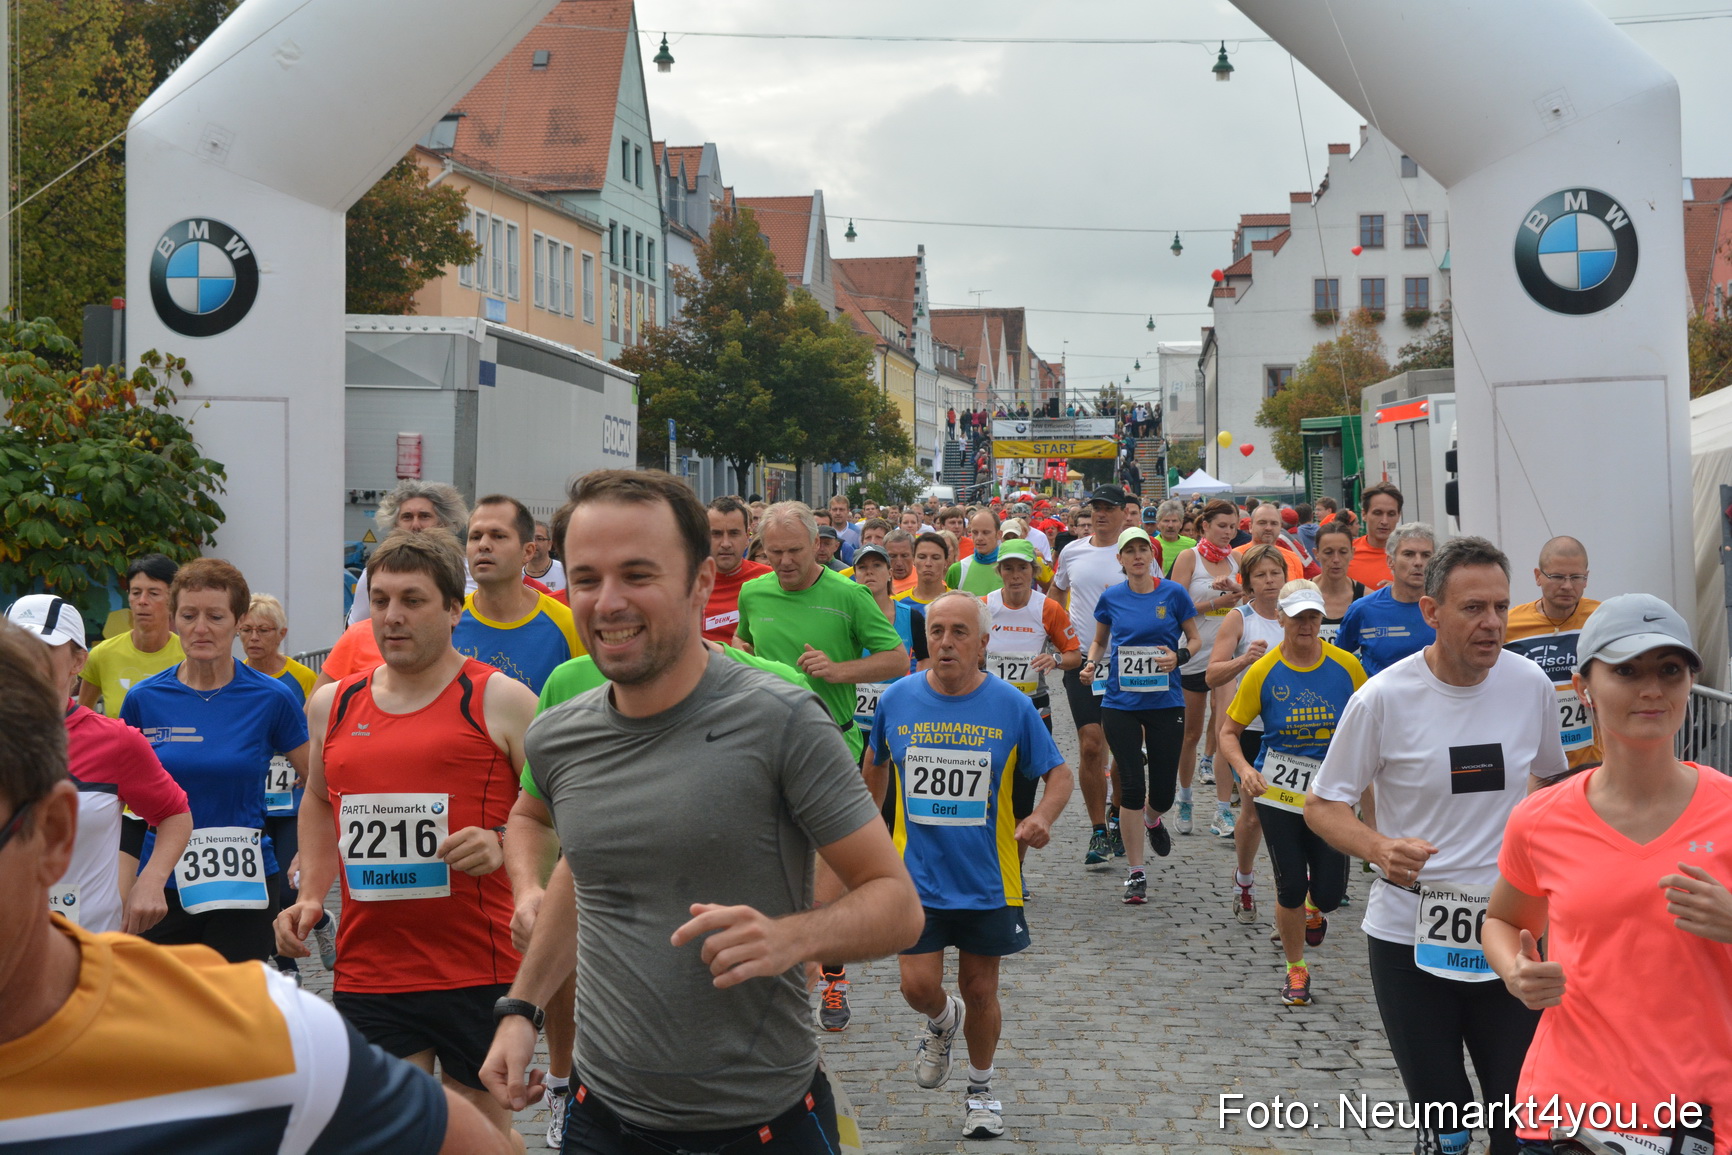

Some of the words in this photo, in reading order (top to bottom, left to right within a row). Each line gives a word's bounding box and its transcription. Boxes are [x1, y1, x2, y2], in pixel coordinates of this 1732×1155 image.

[1524, 191, 1629, 234] BMW
[157, 220, 250, 260] BMW
[602, 414, 632, 458] BOCK
[1033, 443, 1077, 454] START
[1003, 625, 1035, 633] KLEBL
[997, 662, 1028, 680] 127
[898, 724, 911, 736] 10.
[913, 722, 1004, 740] NEUMARKTER
[910, 733, 986, 747] STADTLAUF
[907, 755, 935, 764] PARTL
[936, 757, 976, 766] Neumarkt
[1267, 751, 1286, 762] PARTL
[1287, 757, 1317, 770] Neumarkt
[913, 766, 982, 797] 2807
[1272, 763, 1311, 792] 241
[1279, 792, 1294, 803] Eva
[341, 804, 370, 815] PARTL
[372, 804, 427, 815] Neumarkt
[932, 803, 958, 815] Gerd
[205, 835, 249, 844] Neumarkt
[347, 819, 438, 859] 2216
[183, 847, 257, 882] 3398
[362, 869, 417, 886] Markus
